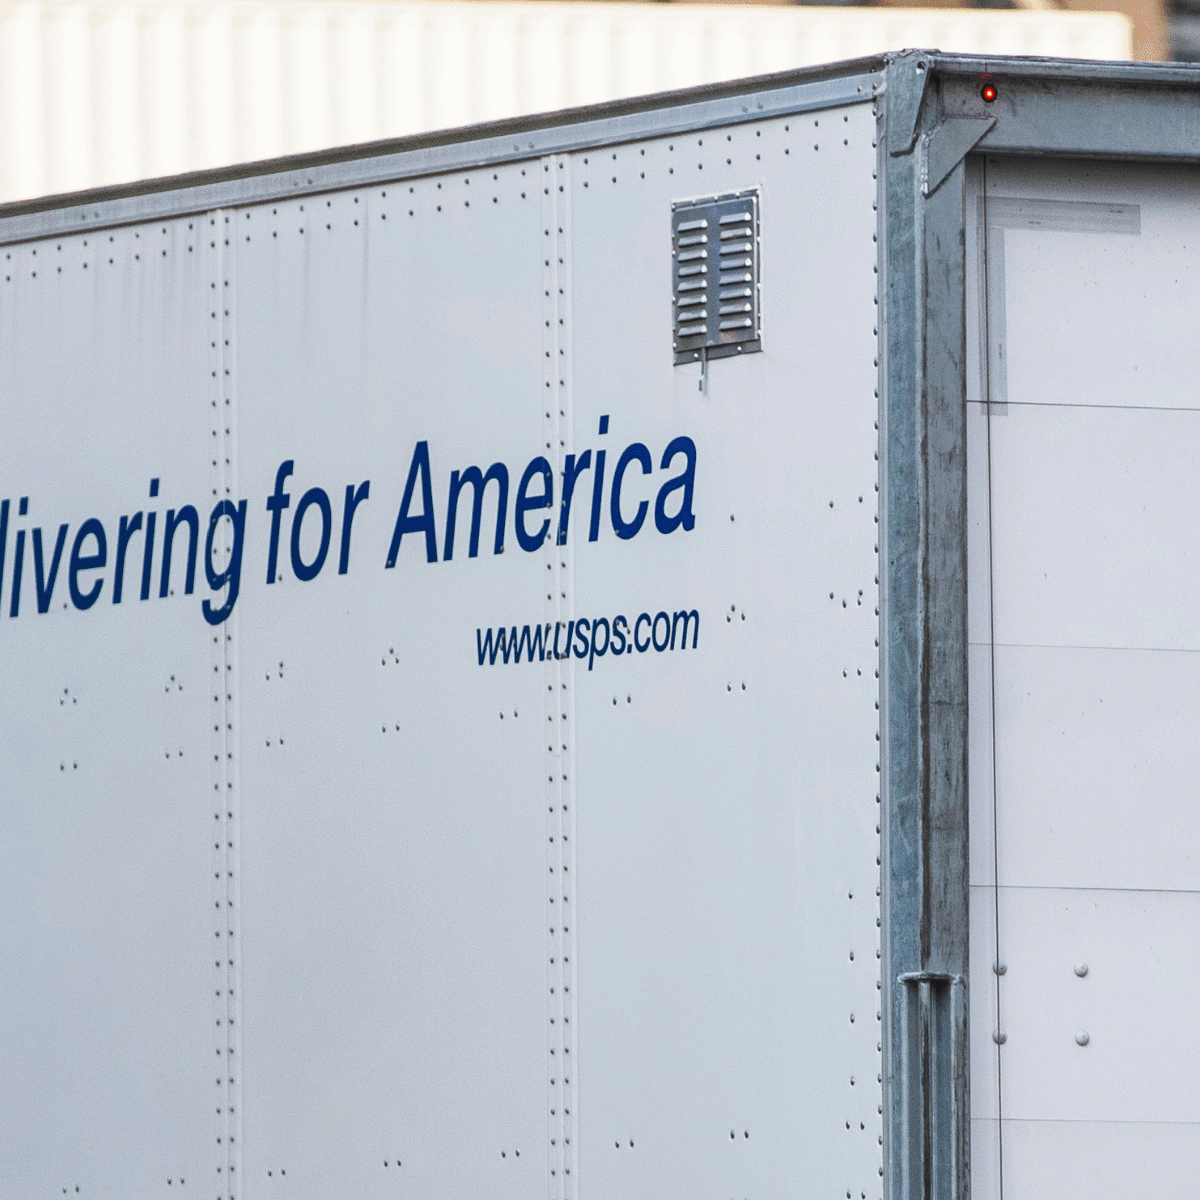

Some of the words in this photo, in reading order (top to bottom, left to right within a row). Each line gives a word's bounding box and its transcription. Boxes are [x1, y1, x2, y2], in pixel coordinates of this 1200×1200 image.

[265, 459, 371, 585] for
[384, 414, 697, 570] America
[476, 609, 700, 672] www.usps.com
